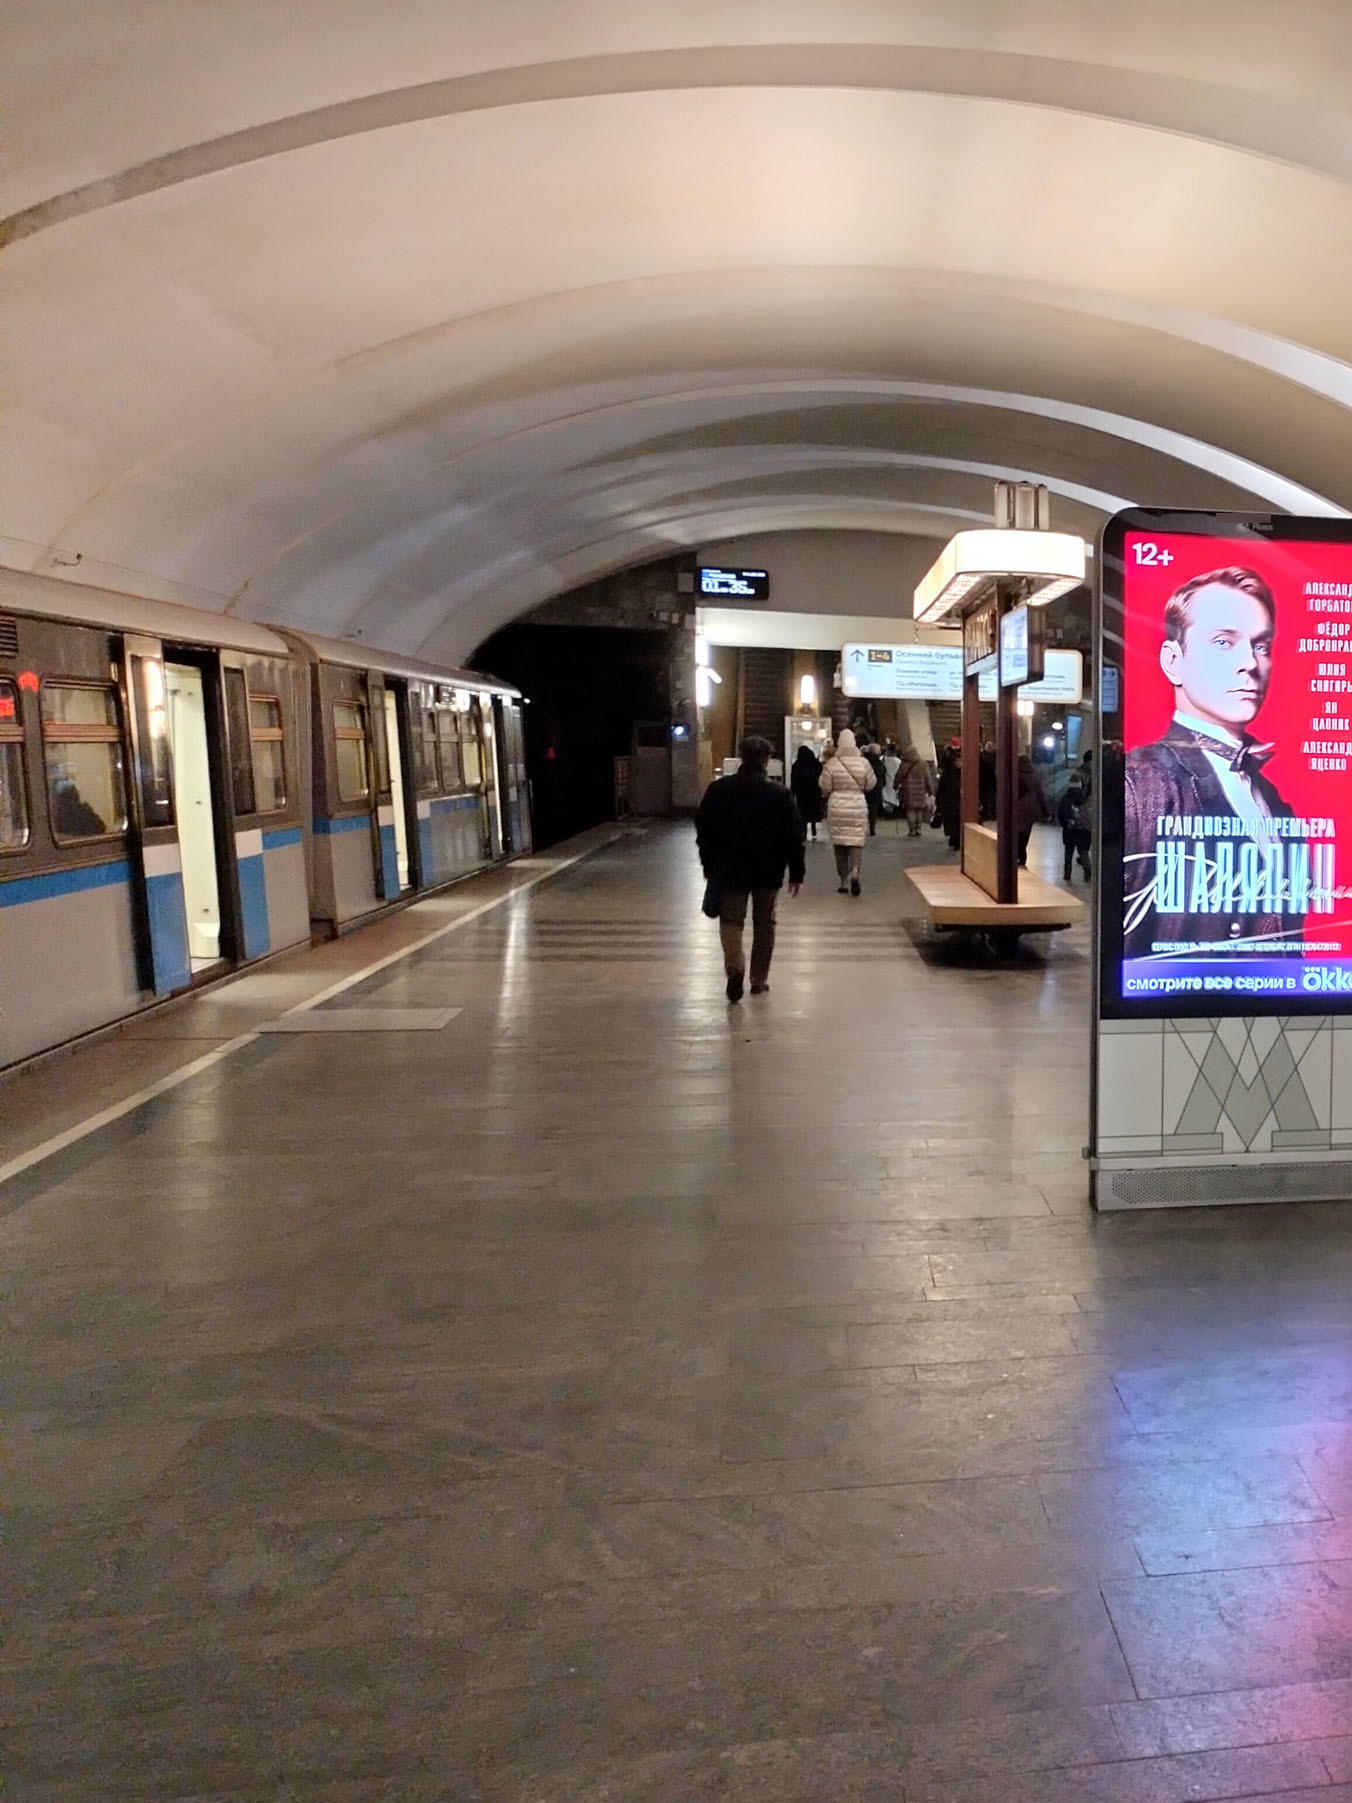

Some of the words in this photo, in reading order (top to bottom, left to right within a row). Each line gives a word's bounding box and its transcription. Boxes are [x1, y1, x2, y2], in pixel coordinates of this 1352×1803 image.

[1132, 542, 1174, 566] 12+
[1316, 621, 1351, 637] ФЁДОР
[1318, 663, 1346, 676] ЮЛИЯ
[1310, 679, 1352, 693] СНИГИРЬ
[1325, 701, 1338, 714] ЯН
[1312, 717, 1350, 731] ЦАПНИК
[1311, 758, 1347, 772] ЯЦЕНКО
[1156, 815, 1259, 839] ГРАНДИОЗНАЯ
[1266, 817, 1336, 838] ПРЕМЬЕРА
[1155, 841, 1336, 914] ШАЛЯПИН
[1126, 977, 1202, 992] смотрите
[1203, 977, 1232, 990] все
[1235, 977, 1284, 992] серии
[1287, 977, 1296, 989] в
